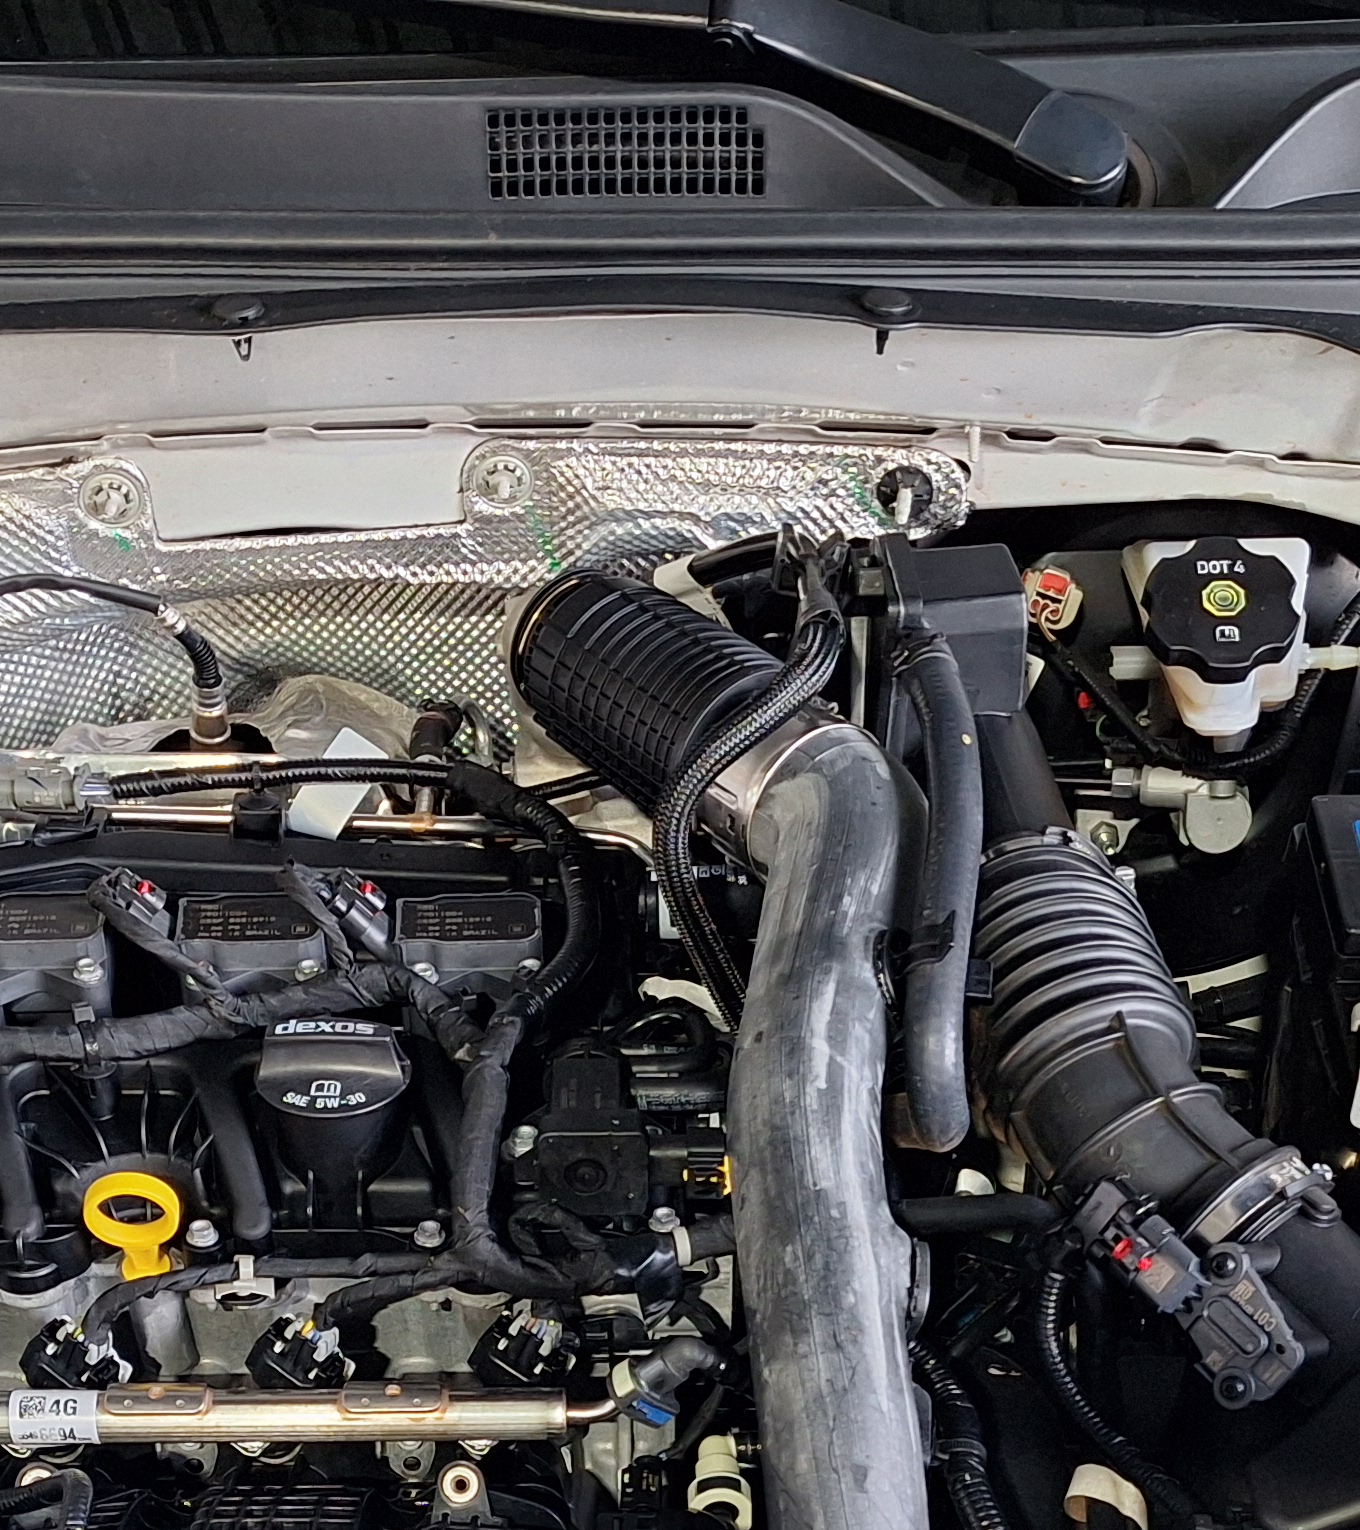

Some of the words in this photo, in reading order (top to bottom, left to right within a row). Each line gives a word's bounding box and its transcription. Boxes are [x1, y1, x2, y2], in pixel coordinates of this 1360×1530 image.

[1196, 560, 1233, 575] DOT
[1234, 559, 1246, 574] 4
[274, 1019, 376, 1036] dexos
[282, 1091, 311, 1107] SAE
[315, 1092, 367, 1109] 5W-30
[48, 1398, 78, 1417] 4G
